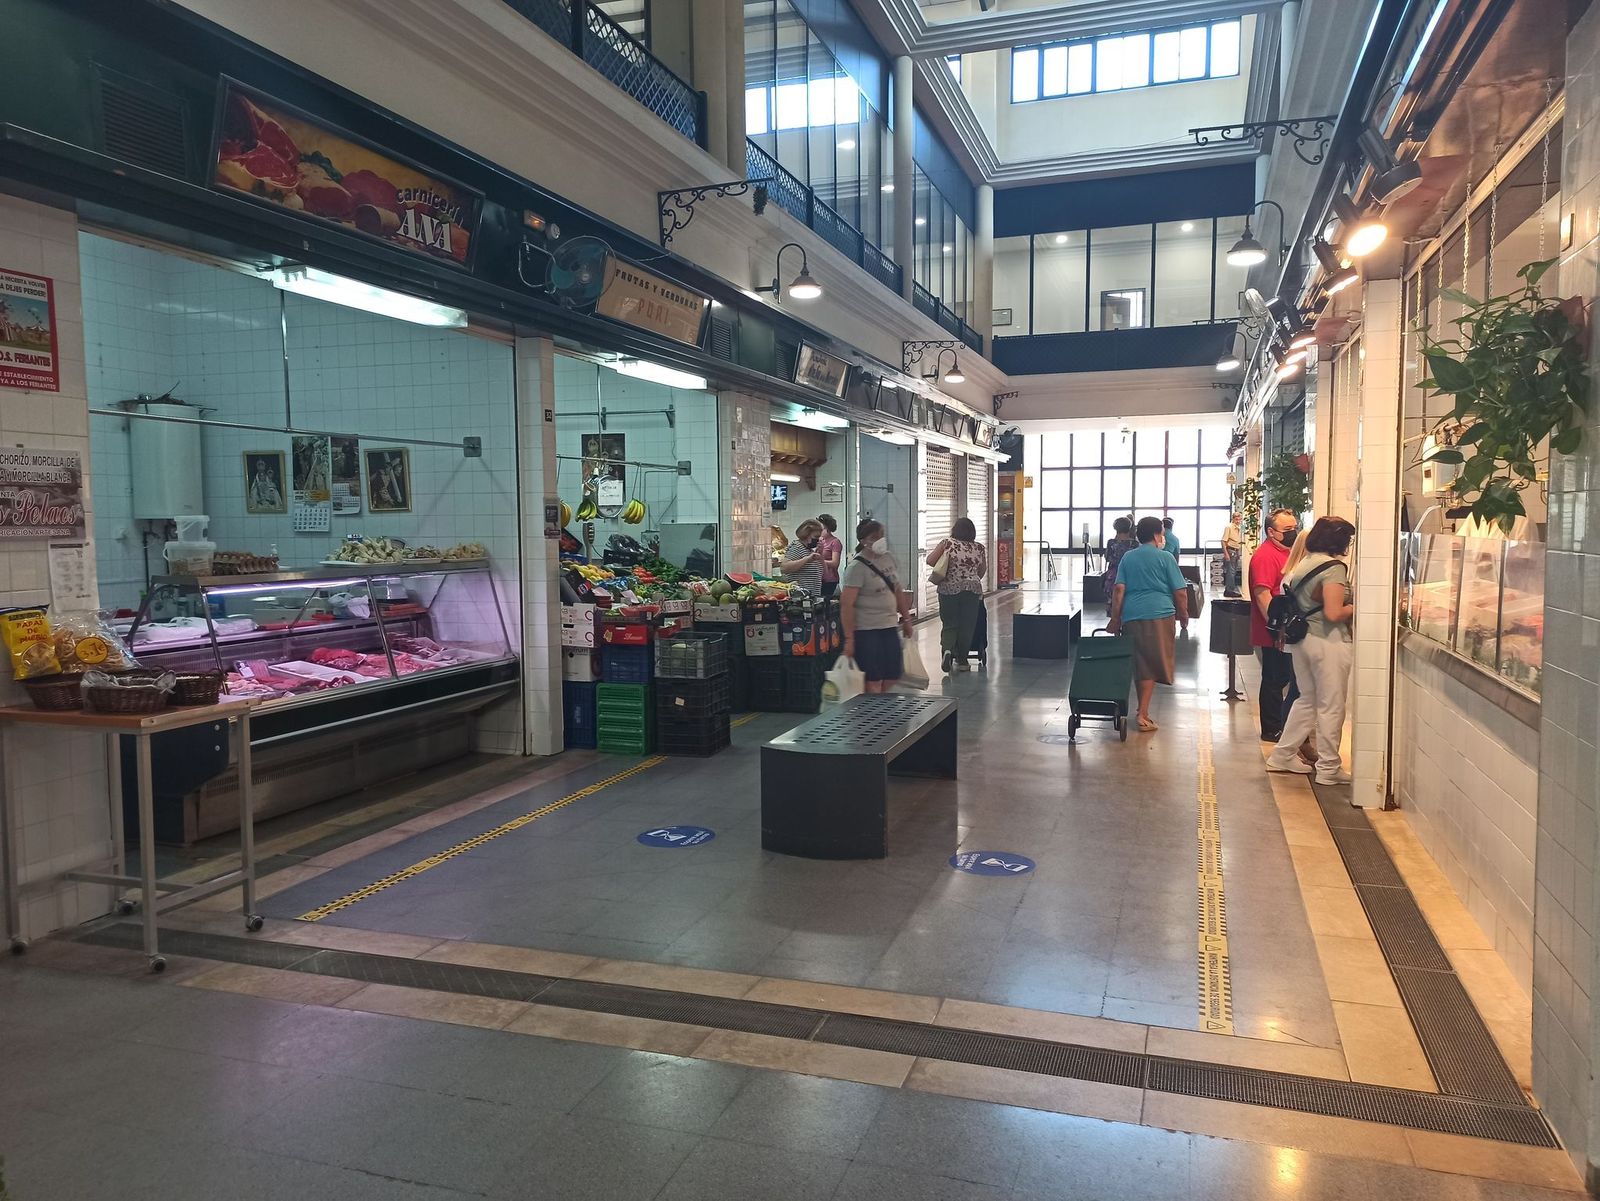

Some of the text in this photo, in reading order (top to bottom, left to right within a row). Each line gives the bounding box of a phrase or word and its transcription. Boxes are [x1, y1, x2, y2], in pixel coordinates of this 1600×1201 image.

[396, 208, 453, 254] ANA
[5, 284, 23, 294] DEJES
[614, 268, 698, 311] FRUTAS Y VERDURAS
[637, 298, 670, 325] PURI
[14, 352, 51, 367] FERIANTES
[4, 371, 54, 382] ESTABLECIMIENTO
[29, 381, 57, 390] FERIANTES
[32, 455, 65, 468] MORCILLA
[12, 471, 45, 482] MORCILLA
[46, 472, 72, 483] BLANCA
[16, 620, 43, 628] PAPAS
[19, 634, 48, 643] PUEBLO
